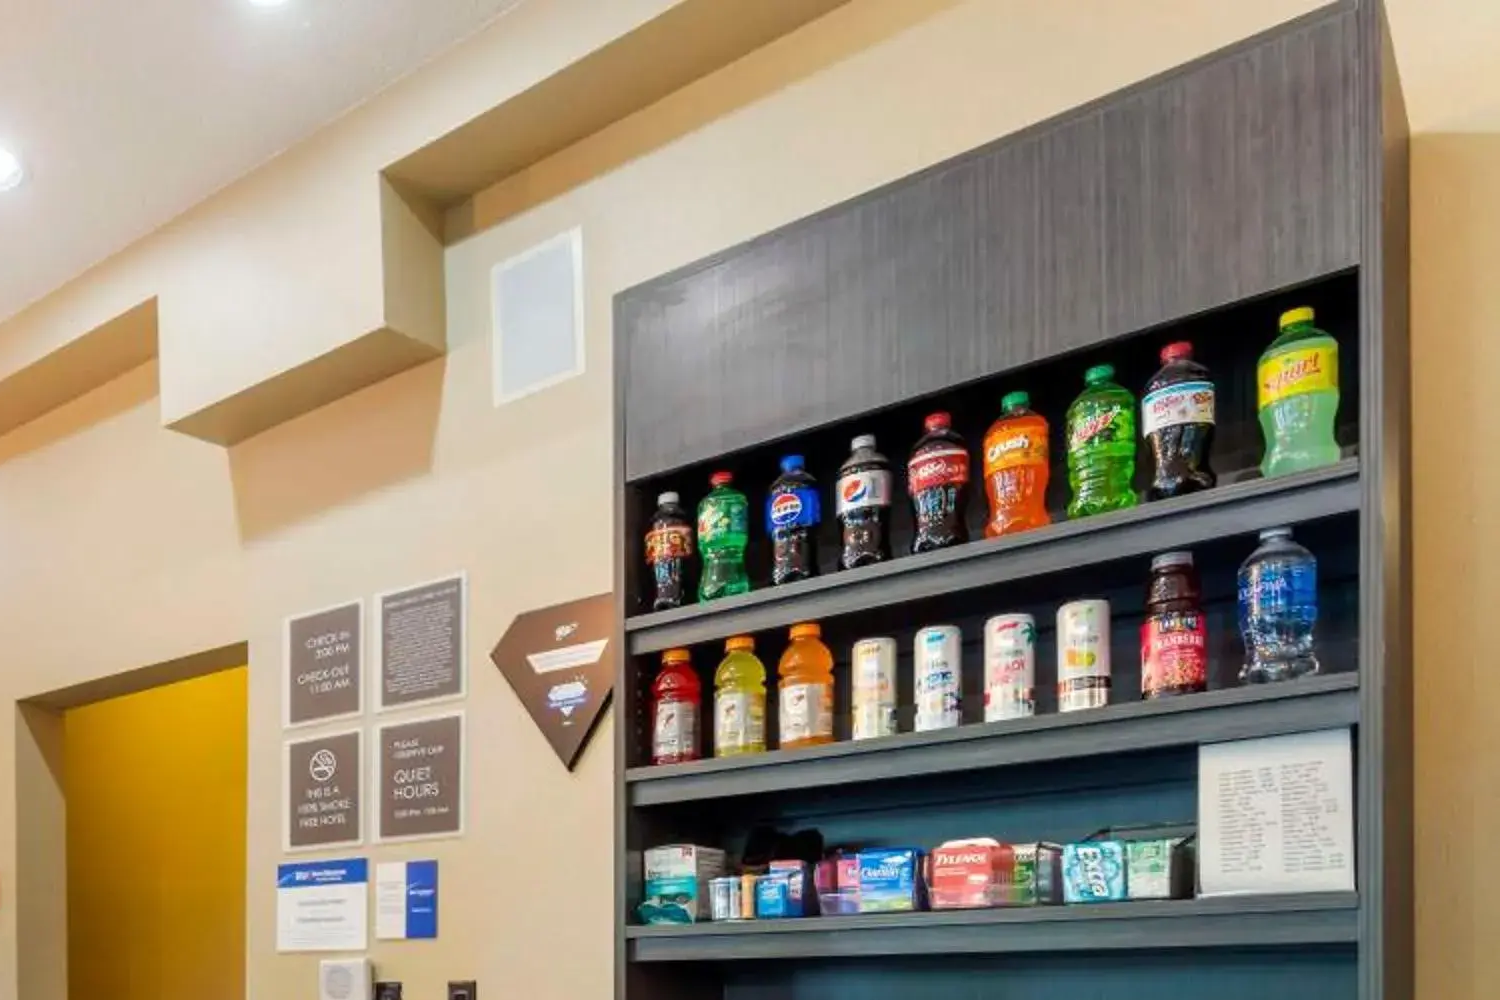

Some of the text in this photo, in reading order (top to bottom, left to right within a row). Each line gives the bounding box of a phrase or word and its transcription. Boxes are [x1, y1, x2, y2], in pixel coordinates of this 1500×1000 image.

[333, 678, 350, 689] AM
[393, 766, 430, 784] QUIET
[393, 782, 440, 800] HOURS
[935, 853, 987, 866] TYLENOL
